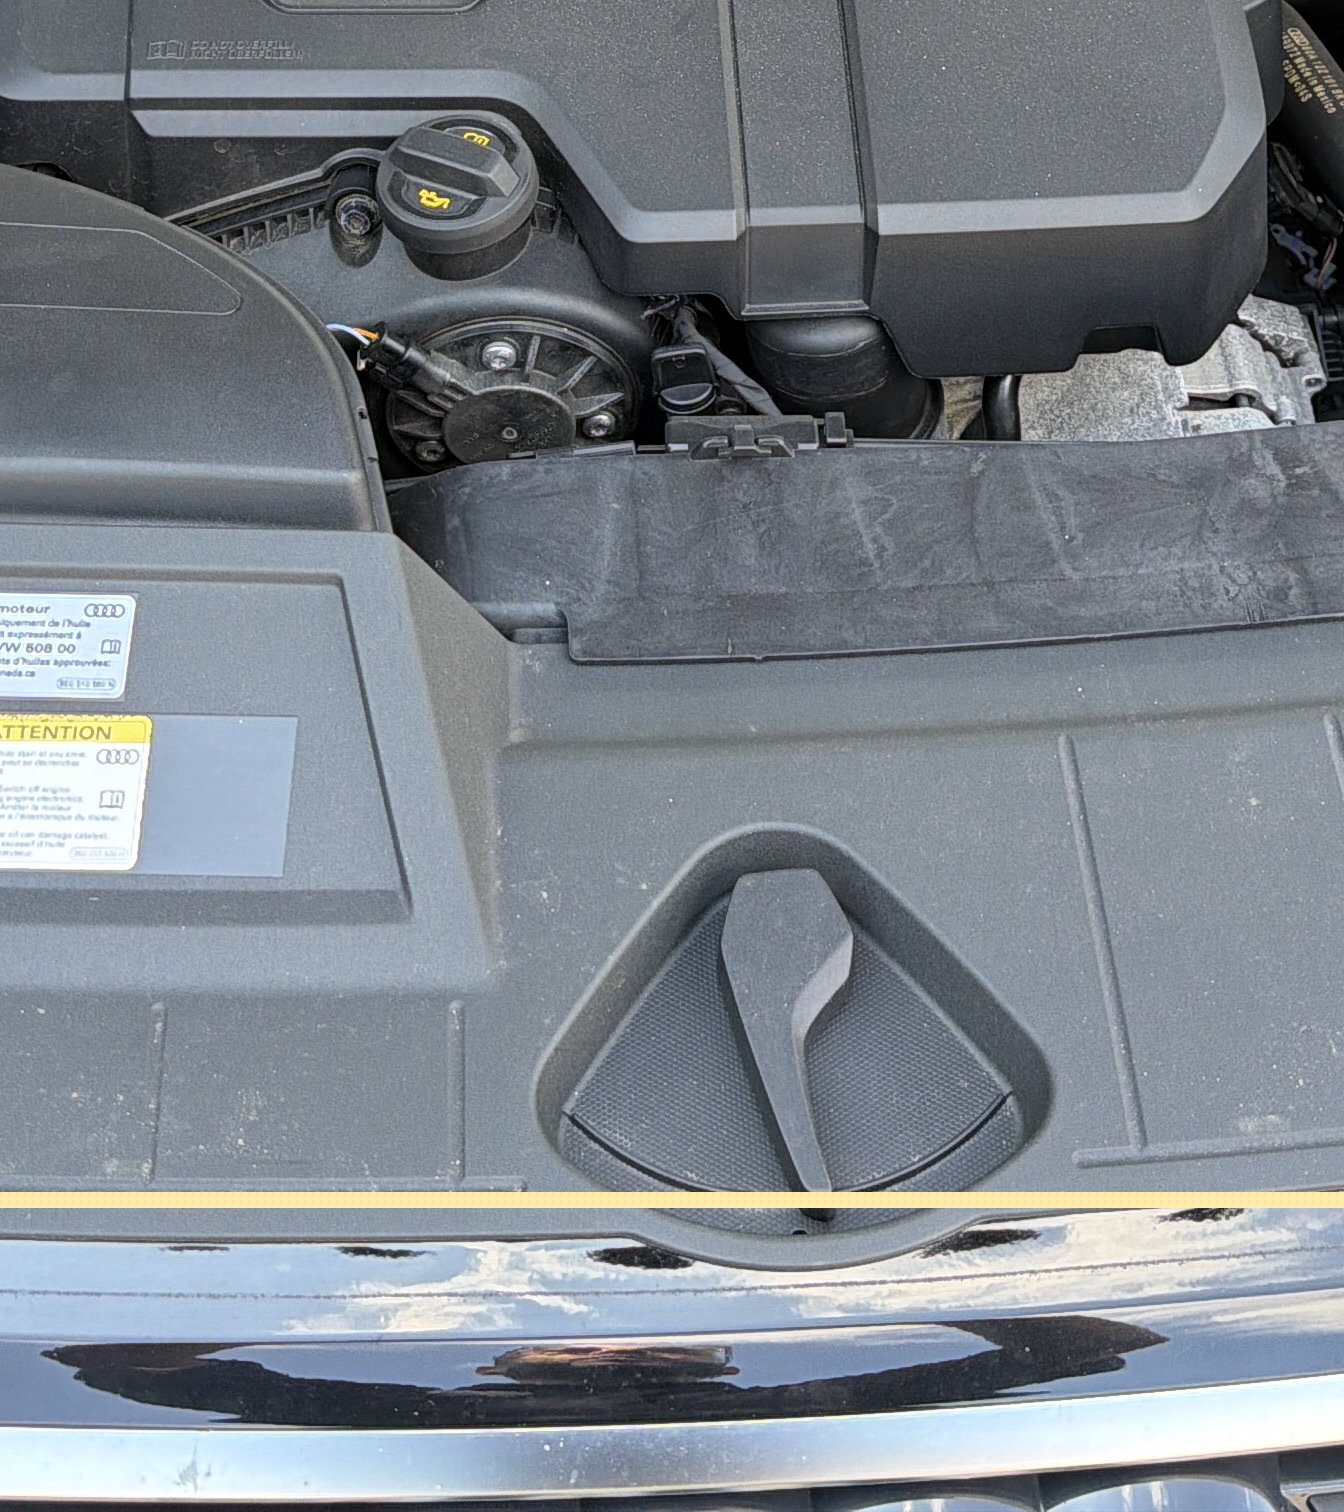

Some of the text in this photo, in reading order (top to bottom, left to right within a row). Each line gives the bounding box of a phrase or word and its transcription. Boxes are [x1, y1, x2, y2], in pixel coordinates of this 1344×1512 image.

[47, 619, 60, 627] de
[25, 643, 53, 653] 508
[57, 644, 76, 654] 00
